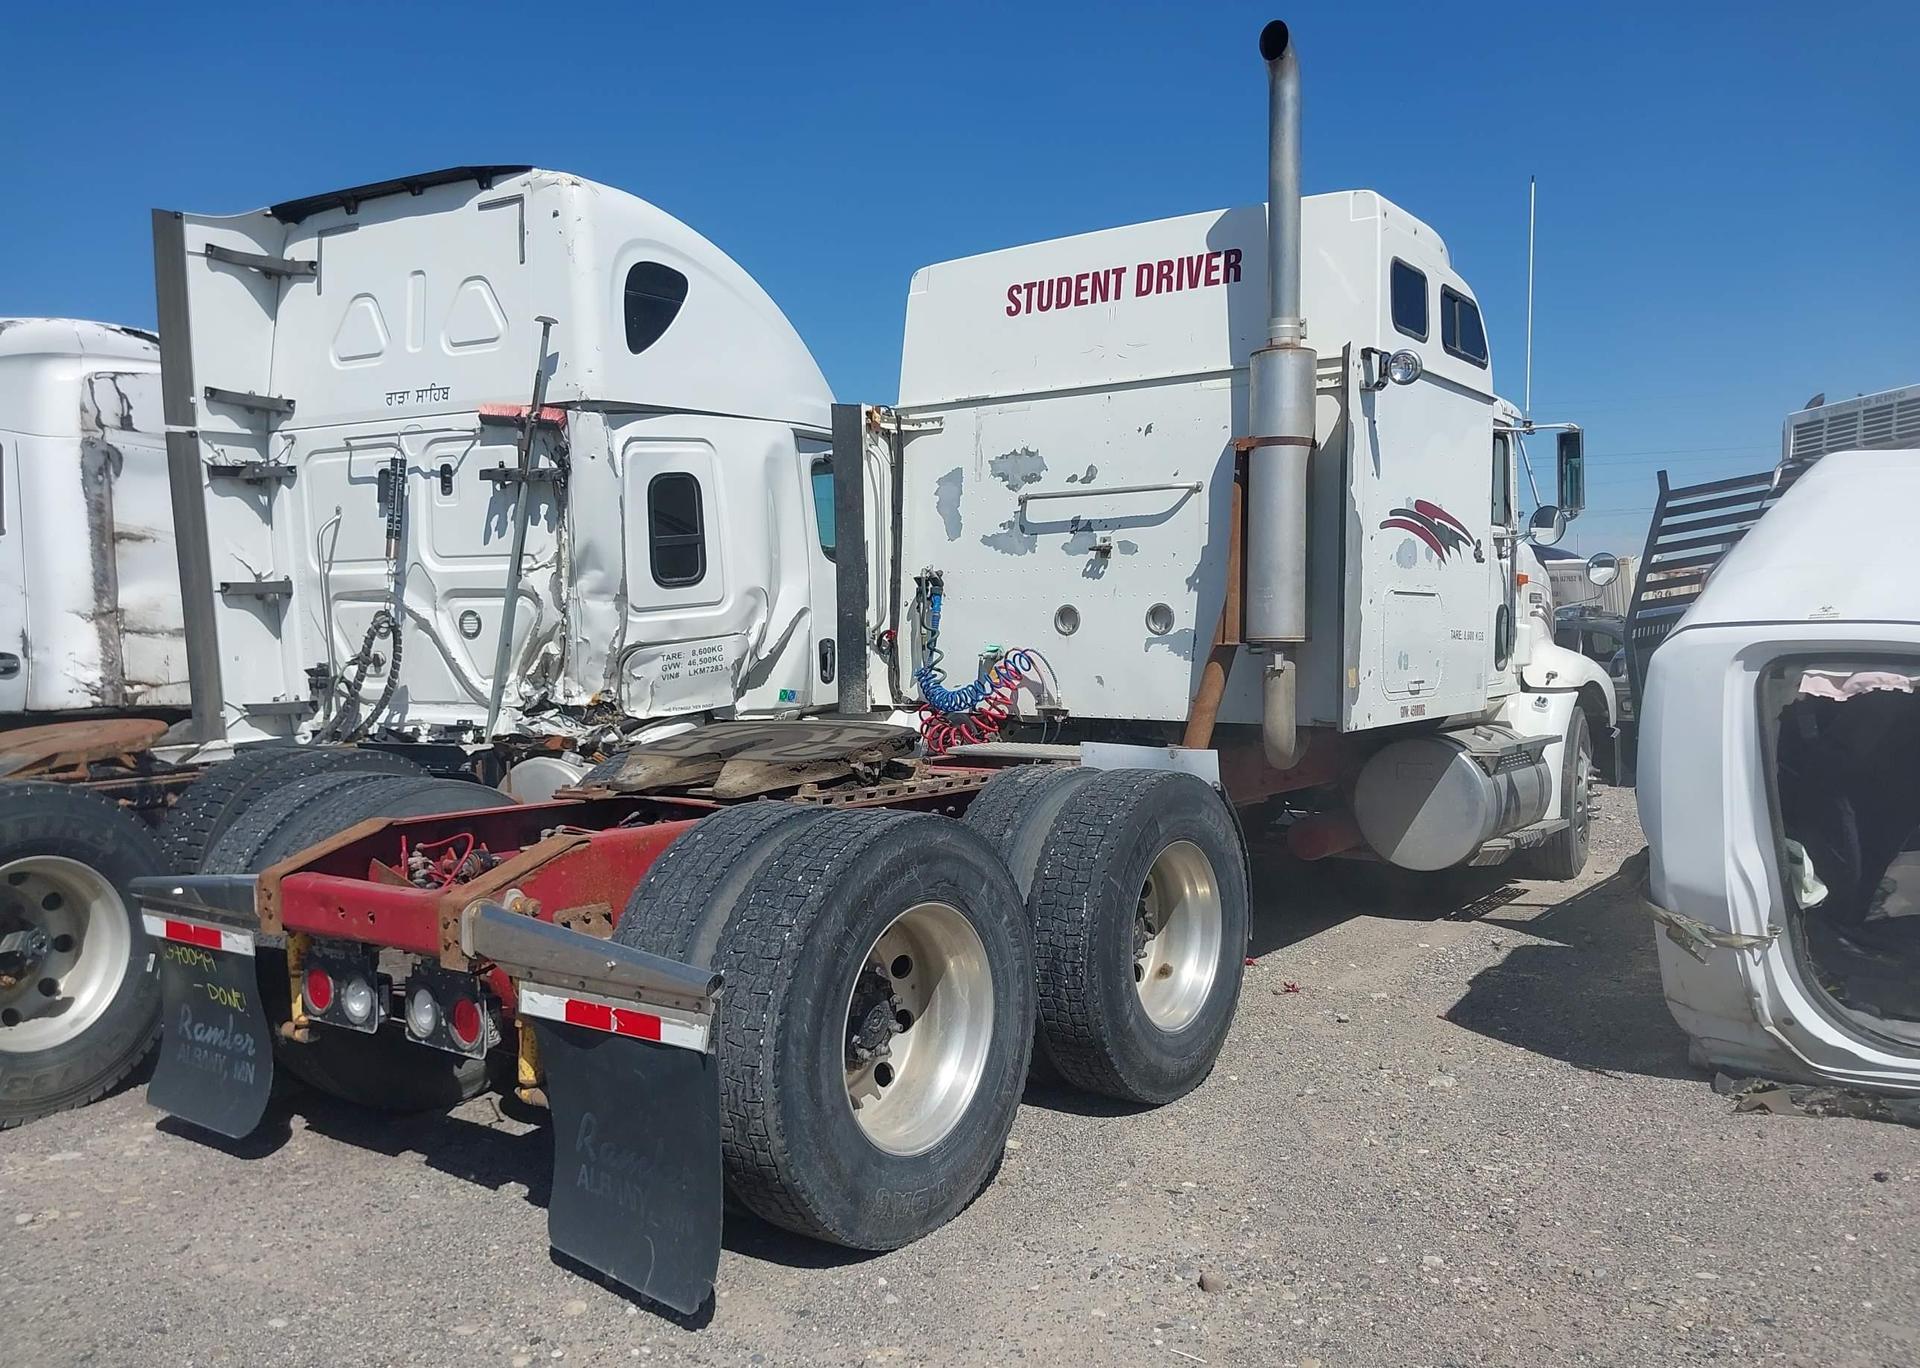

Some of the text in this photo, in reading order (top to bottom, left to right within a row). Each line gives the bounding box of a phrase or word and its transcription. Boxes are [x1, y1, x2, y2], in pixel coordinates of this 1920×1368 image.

[1006, 248, 1243, 317] STUDENT DRIVER
[415, 382, 451, 403] ਸਾਹਿਬ
[661, 645, 723, 662] TARE: 8,600KG
[661, 655, 724, 672] GVW: 46,500KG
[661, 664, 723, 681] VIN# LKM7283
